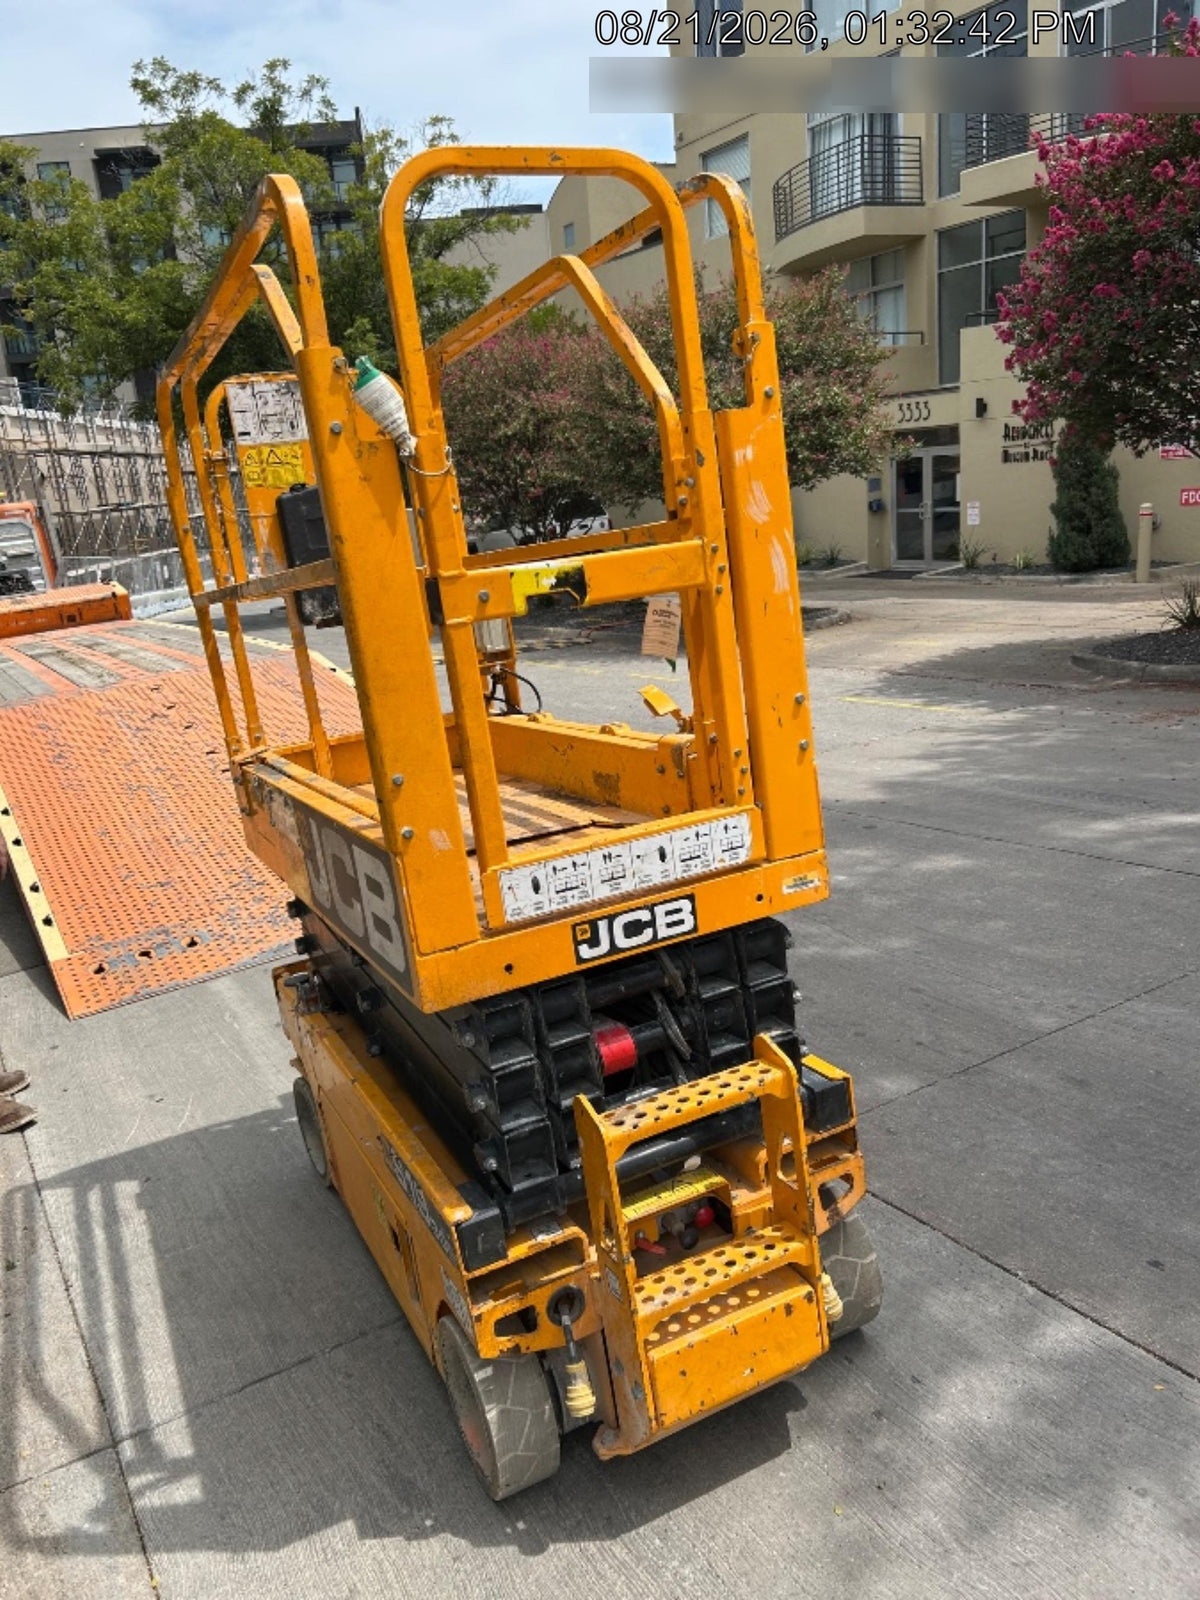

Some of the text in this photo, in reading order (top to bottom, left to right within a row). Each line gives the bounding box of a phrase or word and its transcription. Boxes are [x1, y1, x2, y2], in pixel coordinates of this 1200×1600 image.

[897, 401, 931, 423] 3333
[307, 817, 405, 974] JCB
[576, 898, 696, 961] JCB
